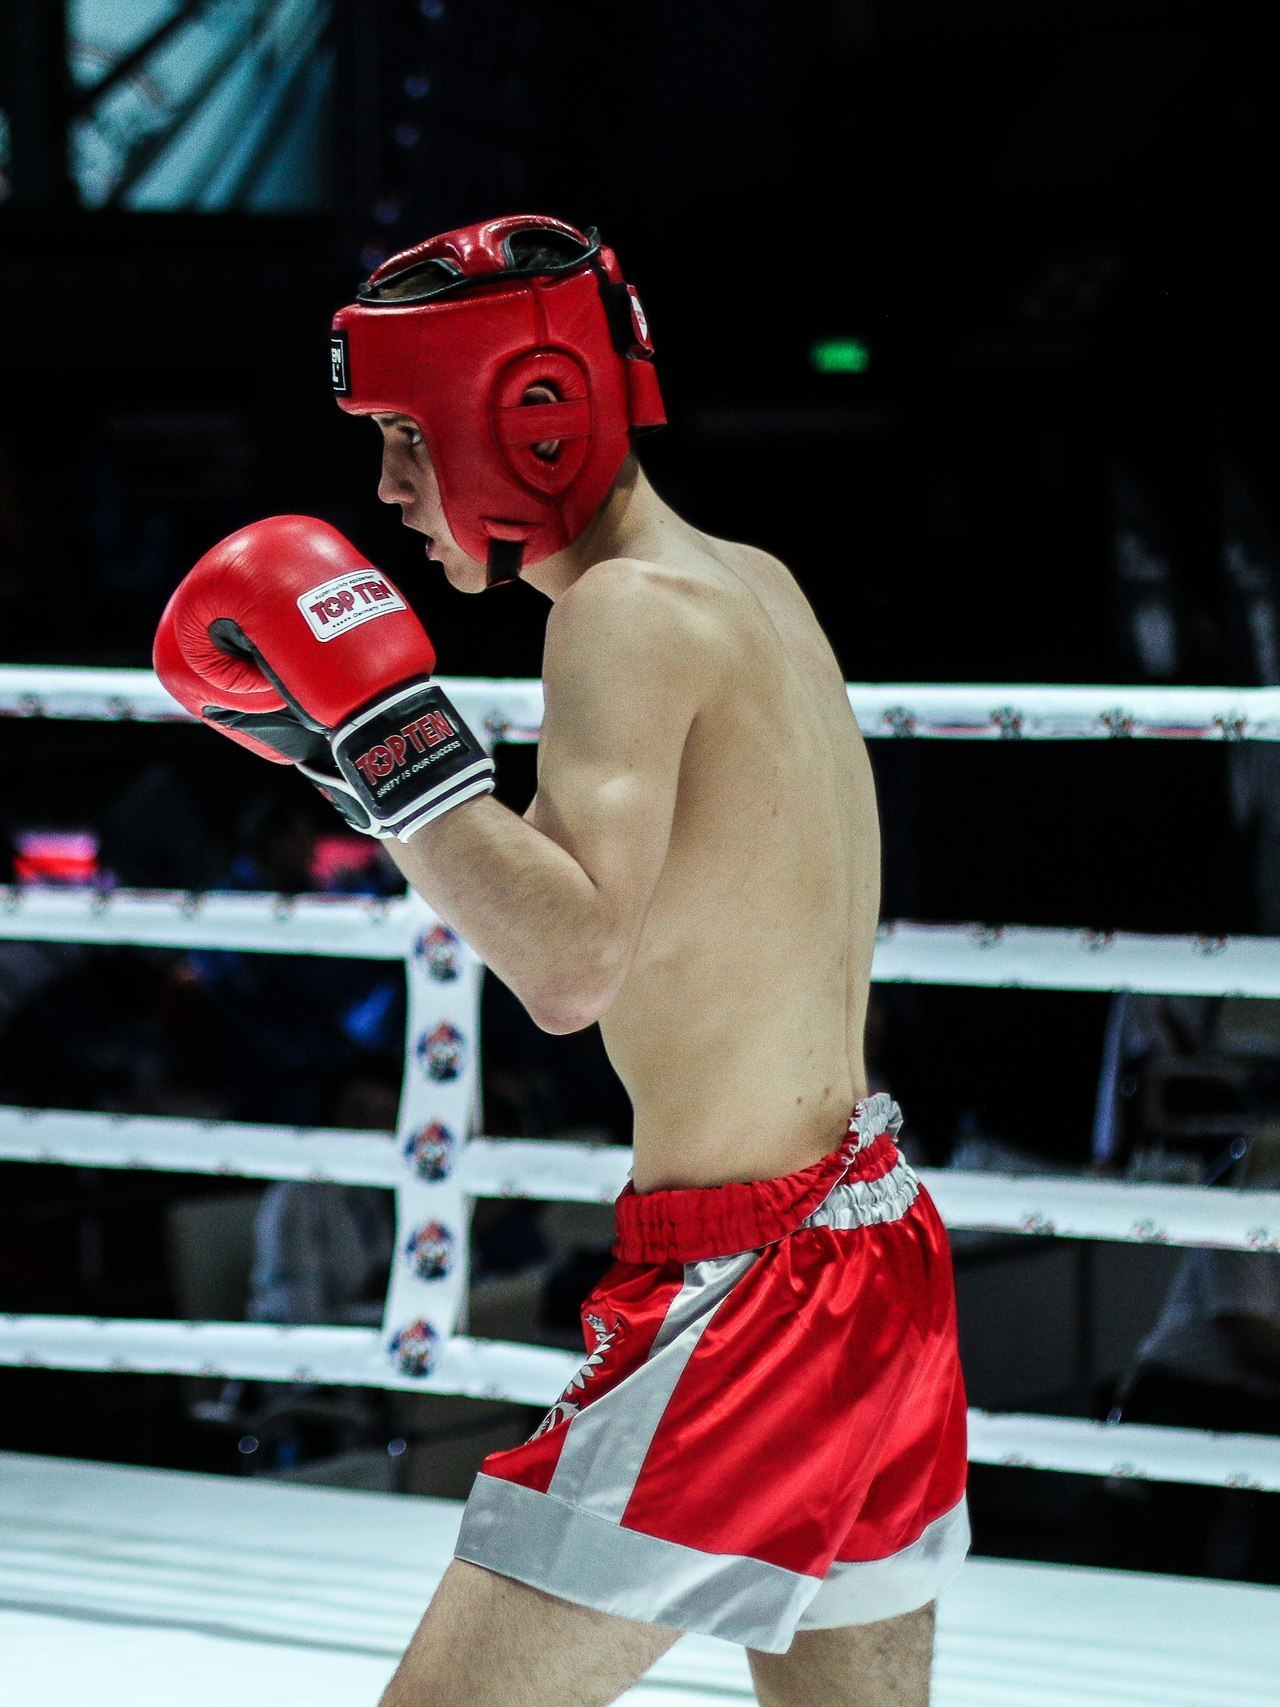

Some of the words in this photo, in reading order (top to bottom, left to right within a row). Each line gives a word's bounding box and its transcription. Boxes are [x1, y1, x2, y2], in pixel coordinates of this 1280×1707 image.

[309, 590, 355, 625] TOP
[351, 580, 395, 604] TEN
[355, 735, 407, 785] TOP
[400, 711, 454, 753] TEN
[401, 769, 411, 780] IS
[411, 758, 431, 773] OUR
[429, 740, 461, 762] SUCCESS
